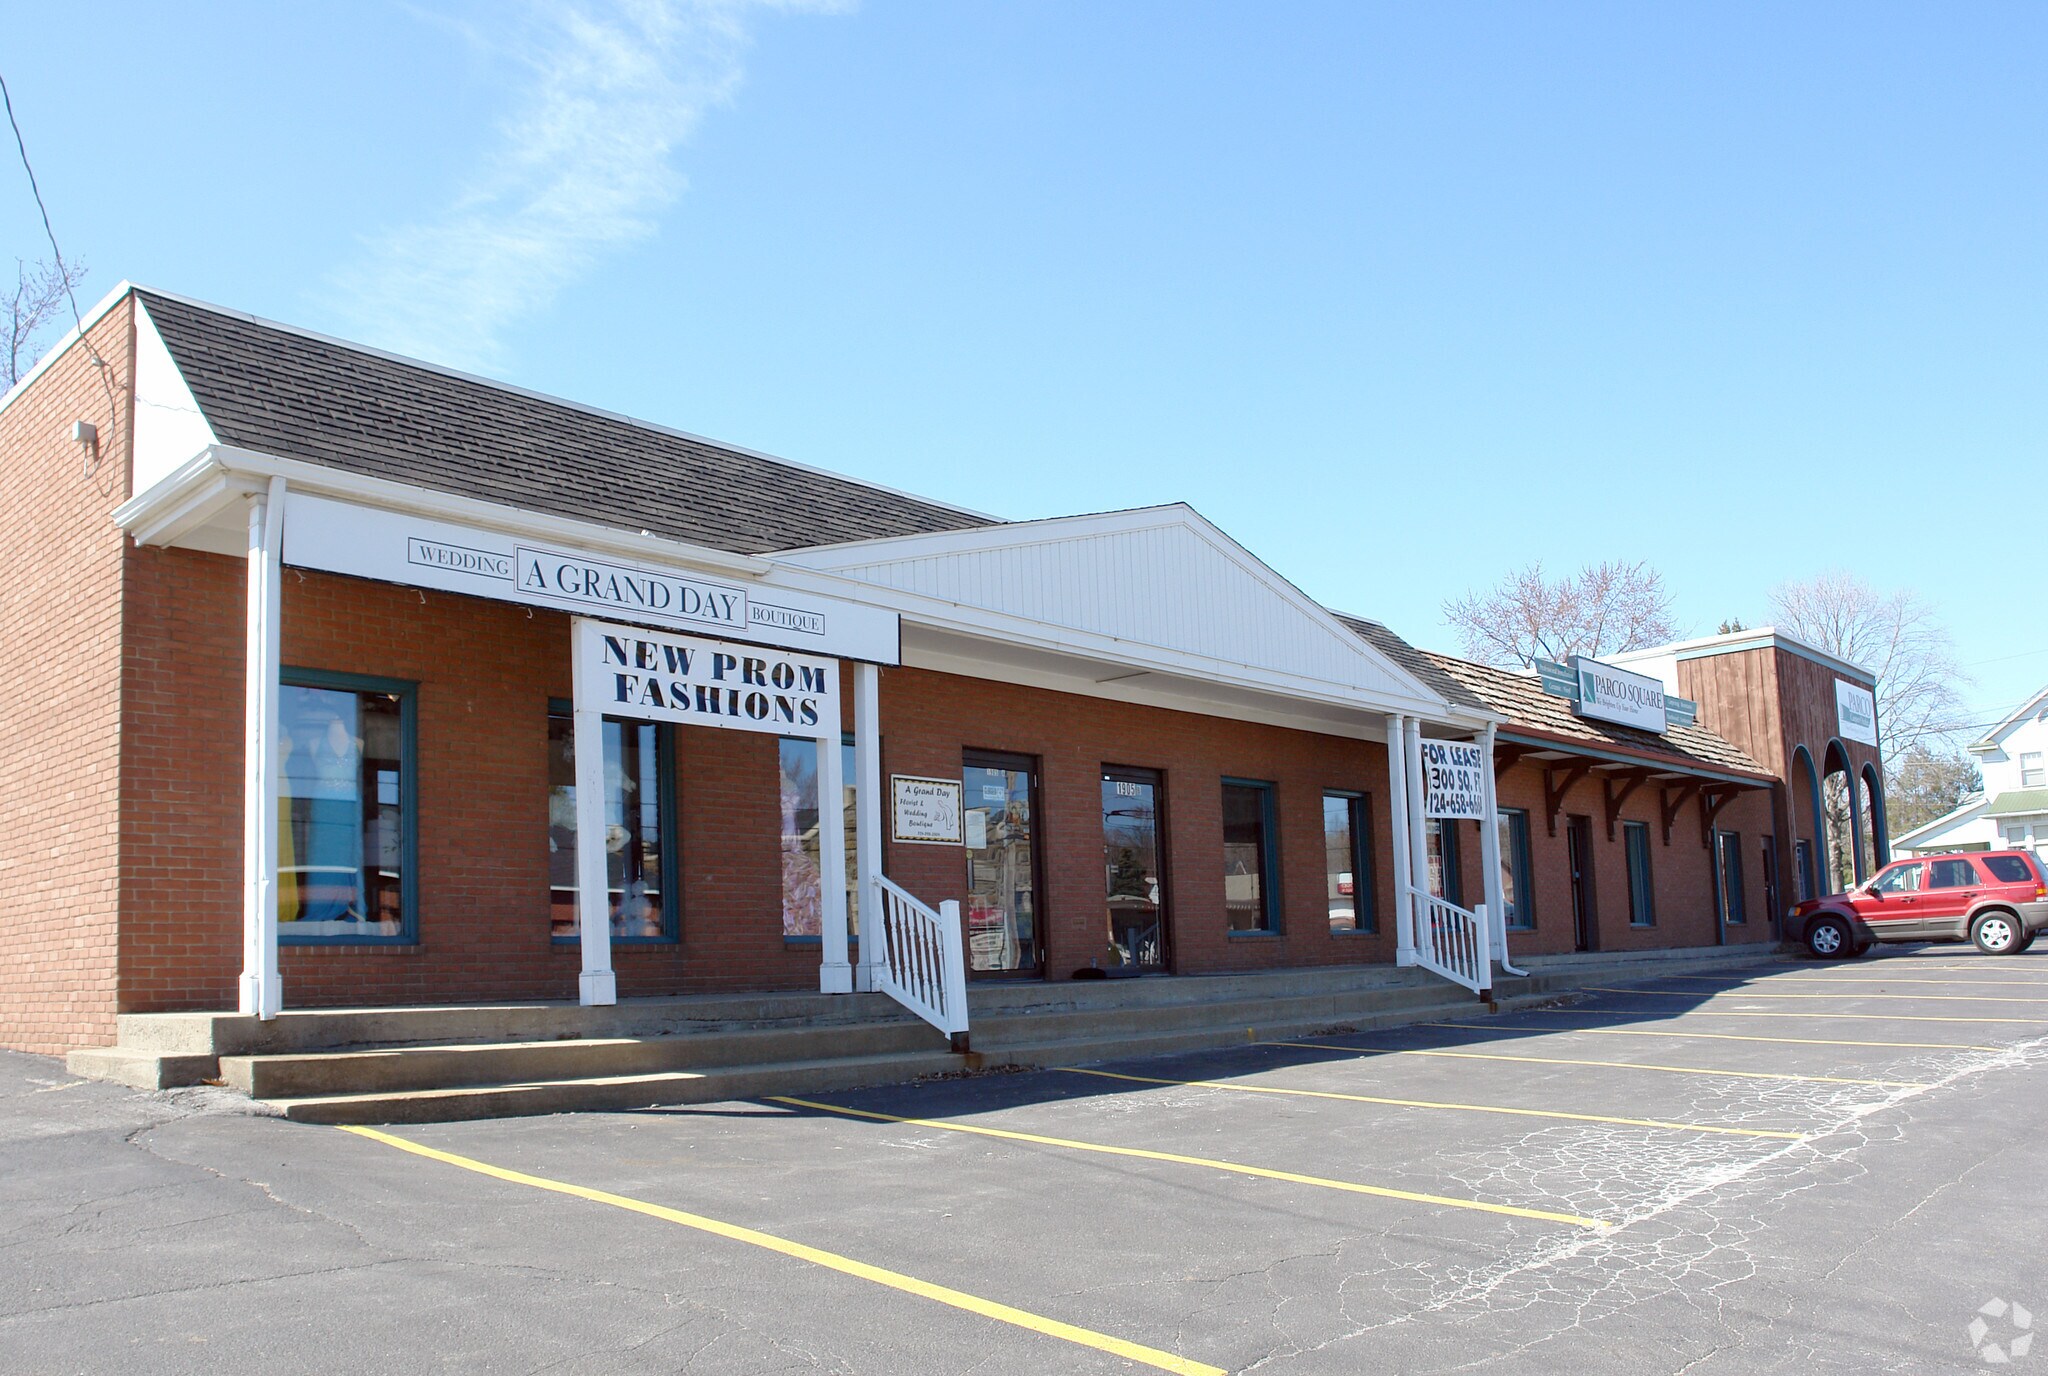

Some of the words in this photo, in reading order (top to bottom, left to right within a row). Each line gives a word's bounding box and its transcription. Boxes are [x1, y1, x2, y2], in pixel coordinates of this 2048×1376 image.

[419, 545, 509, 575] WEDDING
[525, 558, 548, 589] A
[556, 564, 671, 609] GRAND
[678, 585, 738, 622] DAY
[752, 606, 819, 631] BOUTIQUE
[602, 634, 696, 677] NEW
[710, 651, 828, 695] PROM
[613, 673, 819, 727] FASHIONS
[1595, 674, 1627, 700] PARCO
[1627, 683, 1663, 710] SQUARE
[1848, 691, 1872, 717] PARCO
[1421, 743, 1448, 765] FOR
[1449, 745, 1481, 769] LEASE
[899, 798, 918, 806] Florist
[905, 785, 911, 794] A
[913, 786, 934, 796] Grand
[936, 788, 951, 798] Day
[1117, 782, 1135, 796] 1905
[903, 809, 928, 818] Wedding
[908, 820, 933, 828] Boutique
